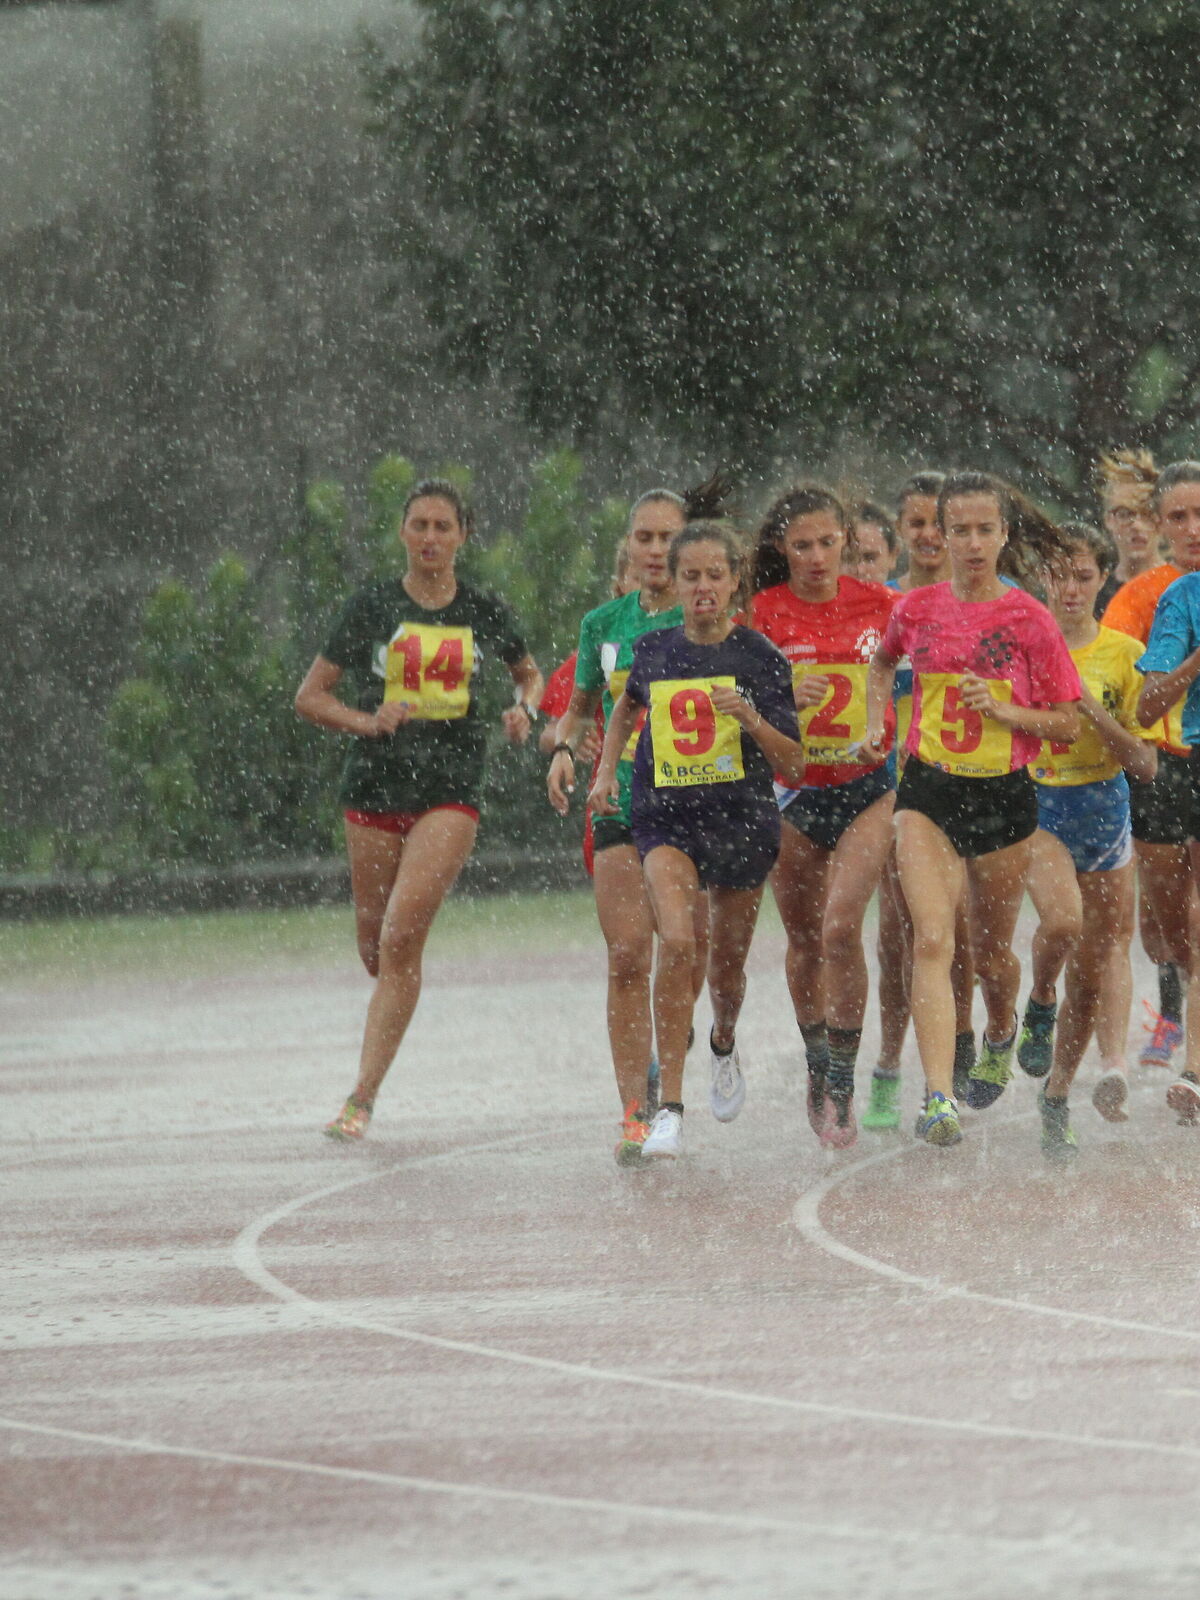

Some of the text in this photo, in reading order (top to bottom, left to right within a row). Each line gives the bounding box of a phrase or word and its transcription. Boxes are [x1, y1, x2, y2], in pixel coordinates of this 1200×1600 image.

[393, 634, 465, 692] 14
[669, 688, 716, 756] 9
[806, 673, 852, 738] 2
[940, 686, 982, 754] 5
[677, 764, 714, 777] BCC
